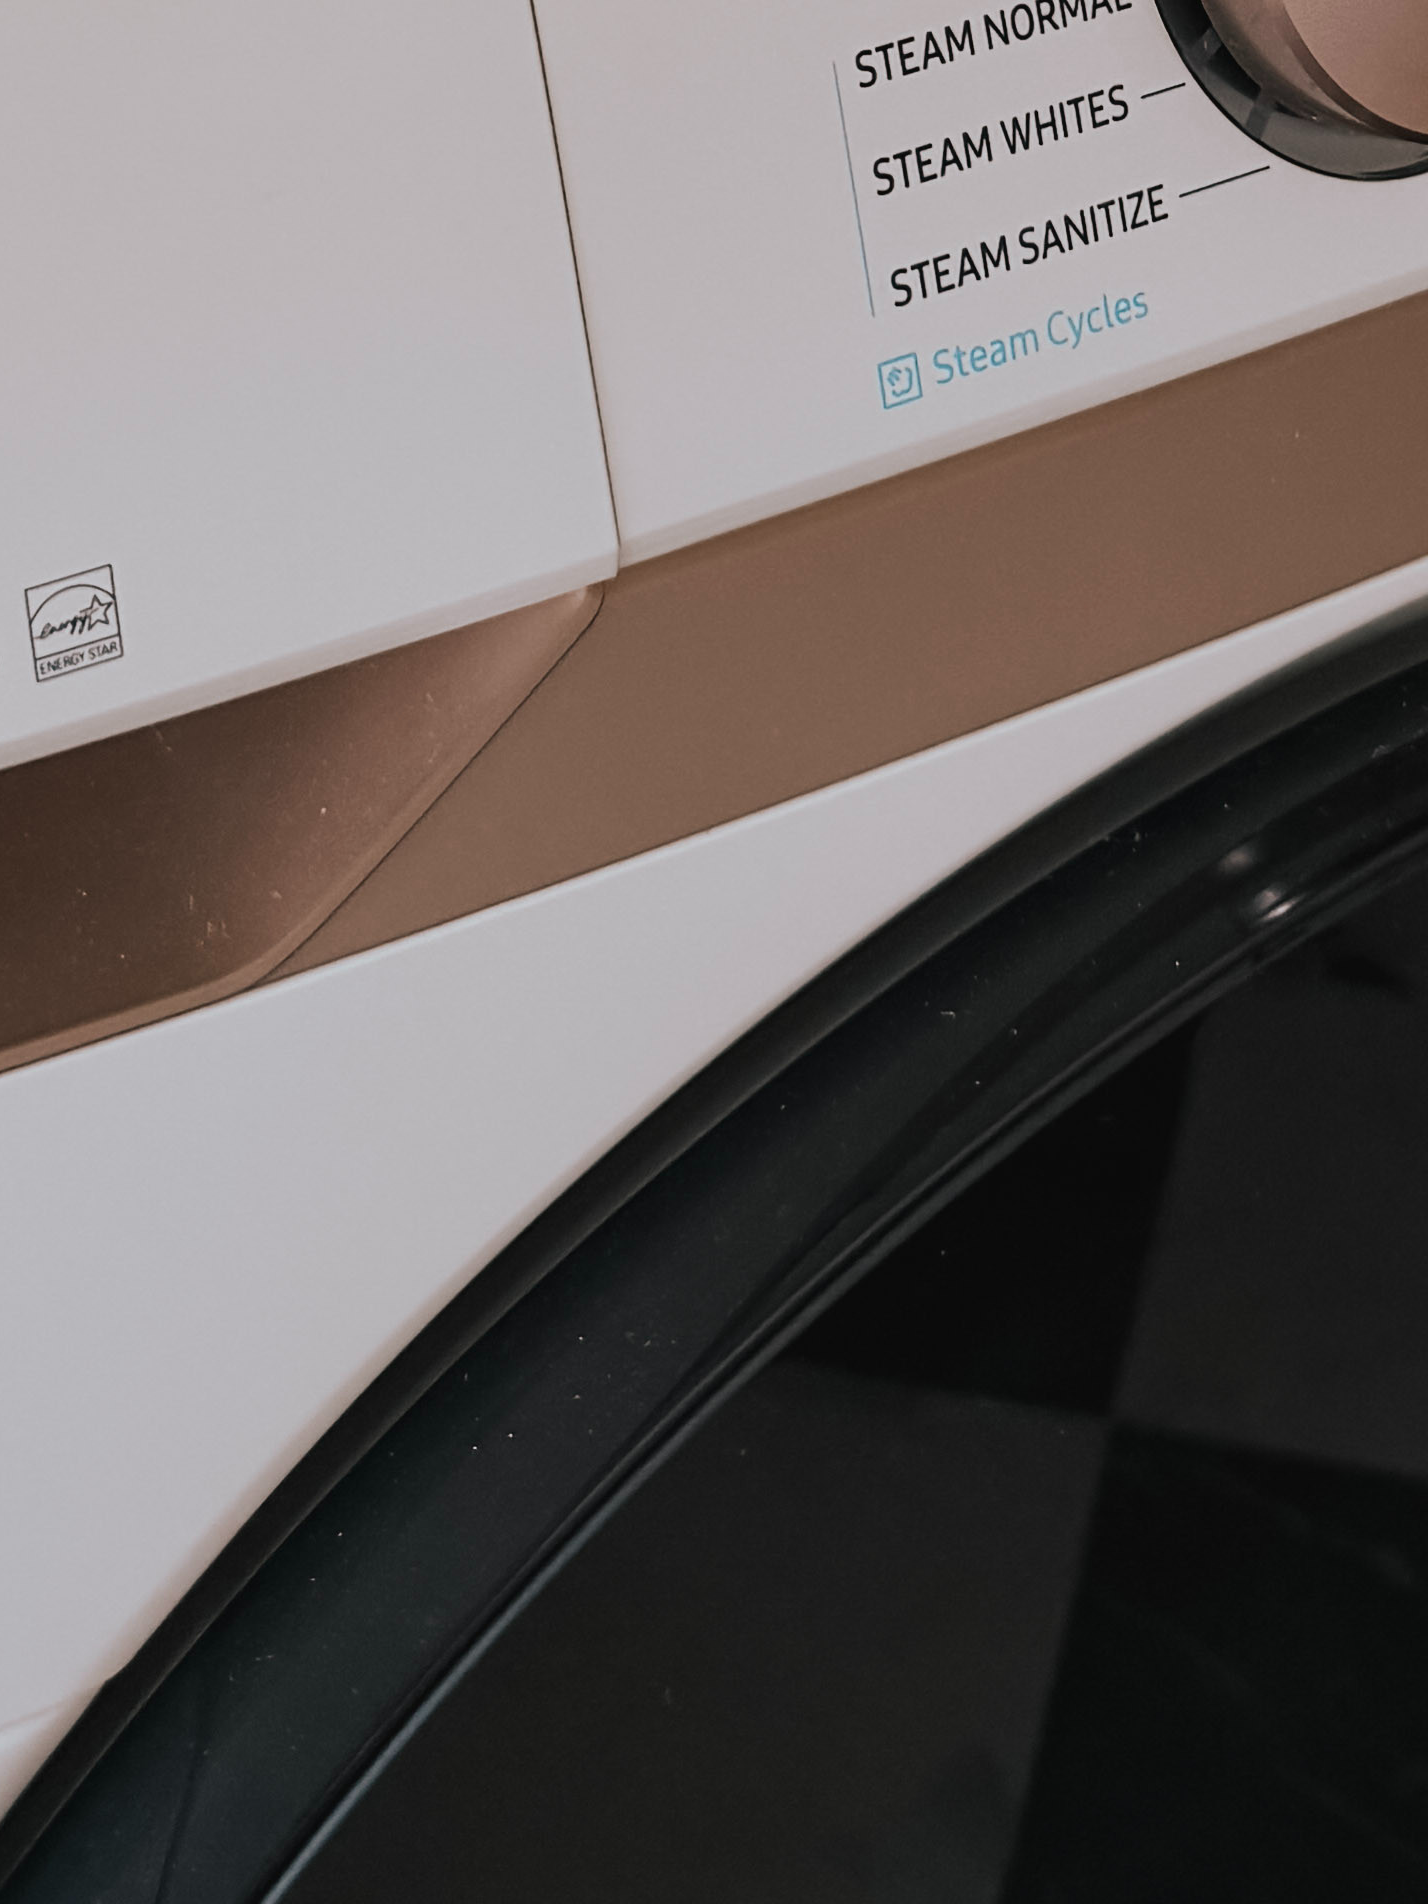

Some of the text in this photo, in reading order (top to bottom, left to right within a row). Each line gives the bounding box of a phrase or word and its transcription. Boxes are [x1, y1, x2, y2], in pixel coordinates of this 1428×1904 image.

[854, 19, 976, 89] STEAM
[871, 83, 1130, 196] STEAM WHITES
[889, 183, 1170, 308] STEAM SANITIZE
[932, 292, 1149, 385] Steam Cycles
[39, 641, 119, 675] ENERGY STAR
